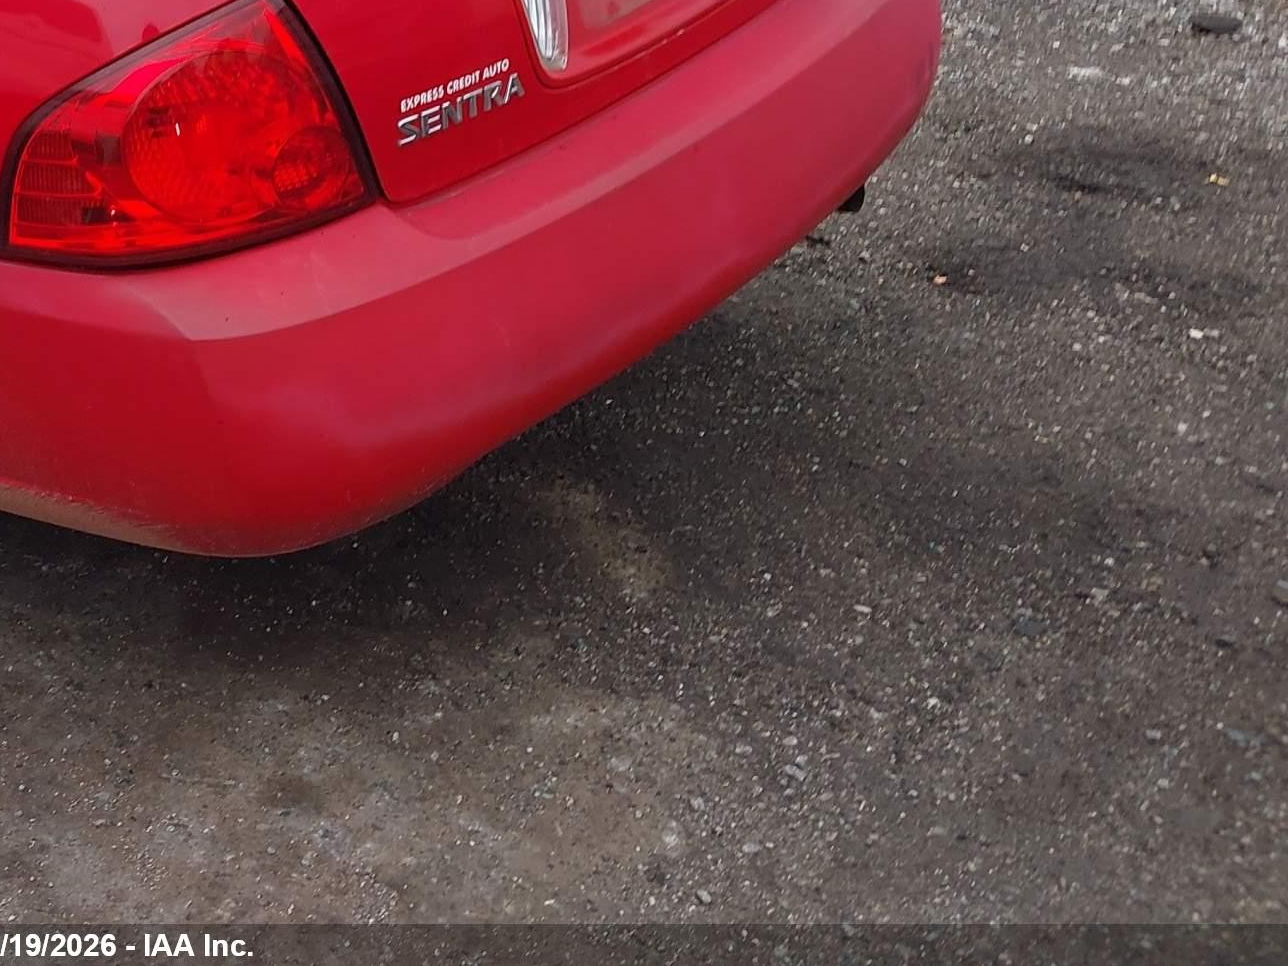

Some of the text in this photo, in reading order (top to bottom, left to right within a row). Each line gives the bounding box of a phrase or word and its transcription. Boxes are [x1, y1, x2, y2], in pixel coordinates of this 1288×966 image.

[397, 72, 526, 147] SENTRA
[400, 57, 510, 113] EXPRESS CREDIT AUTO
